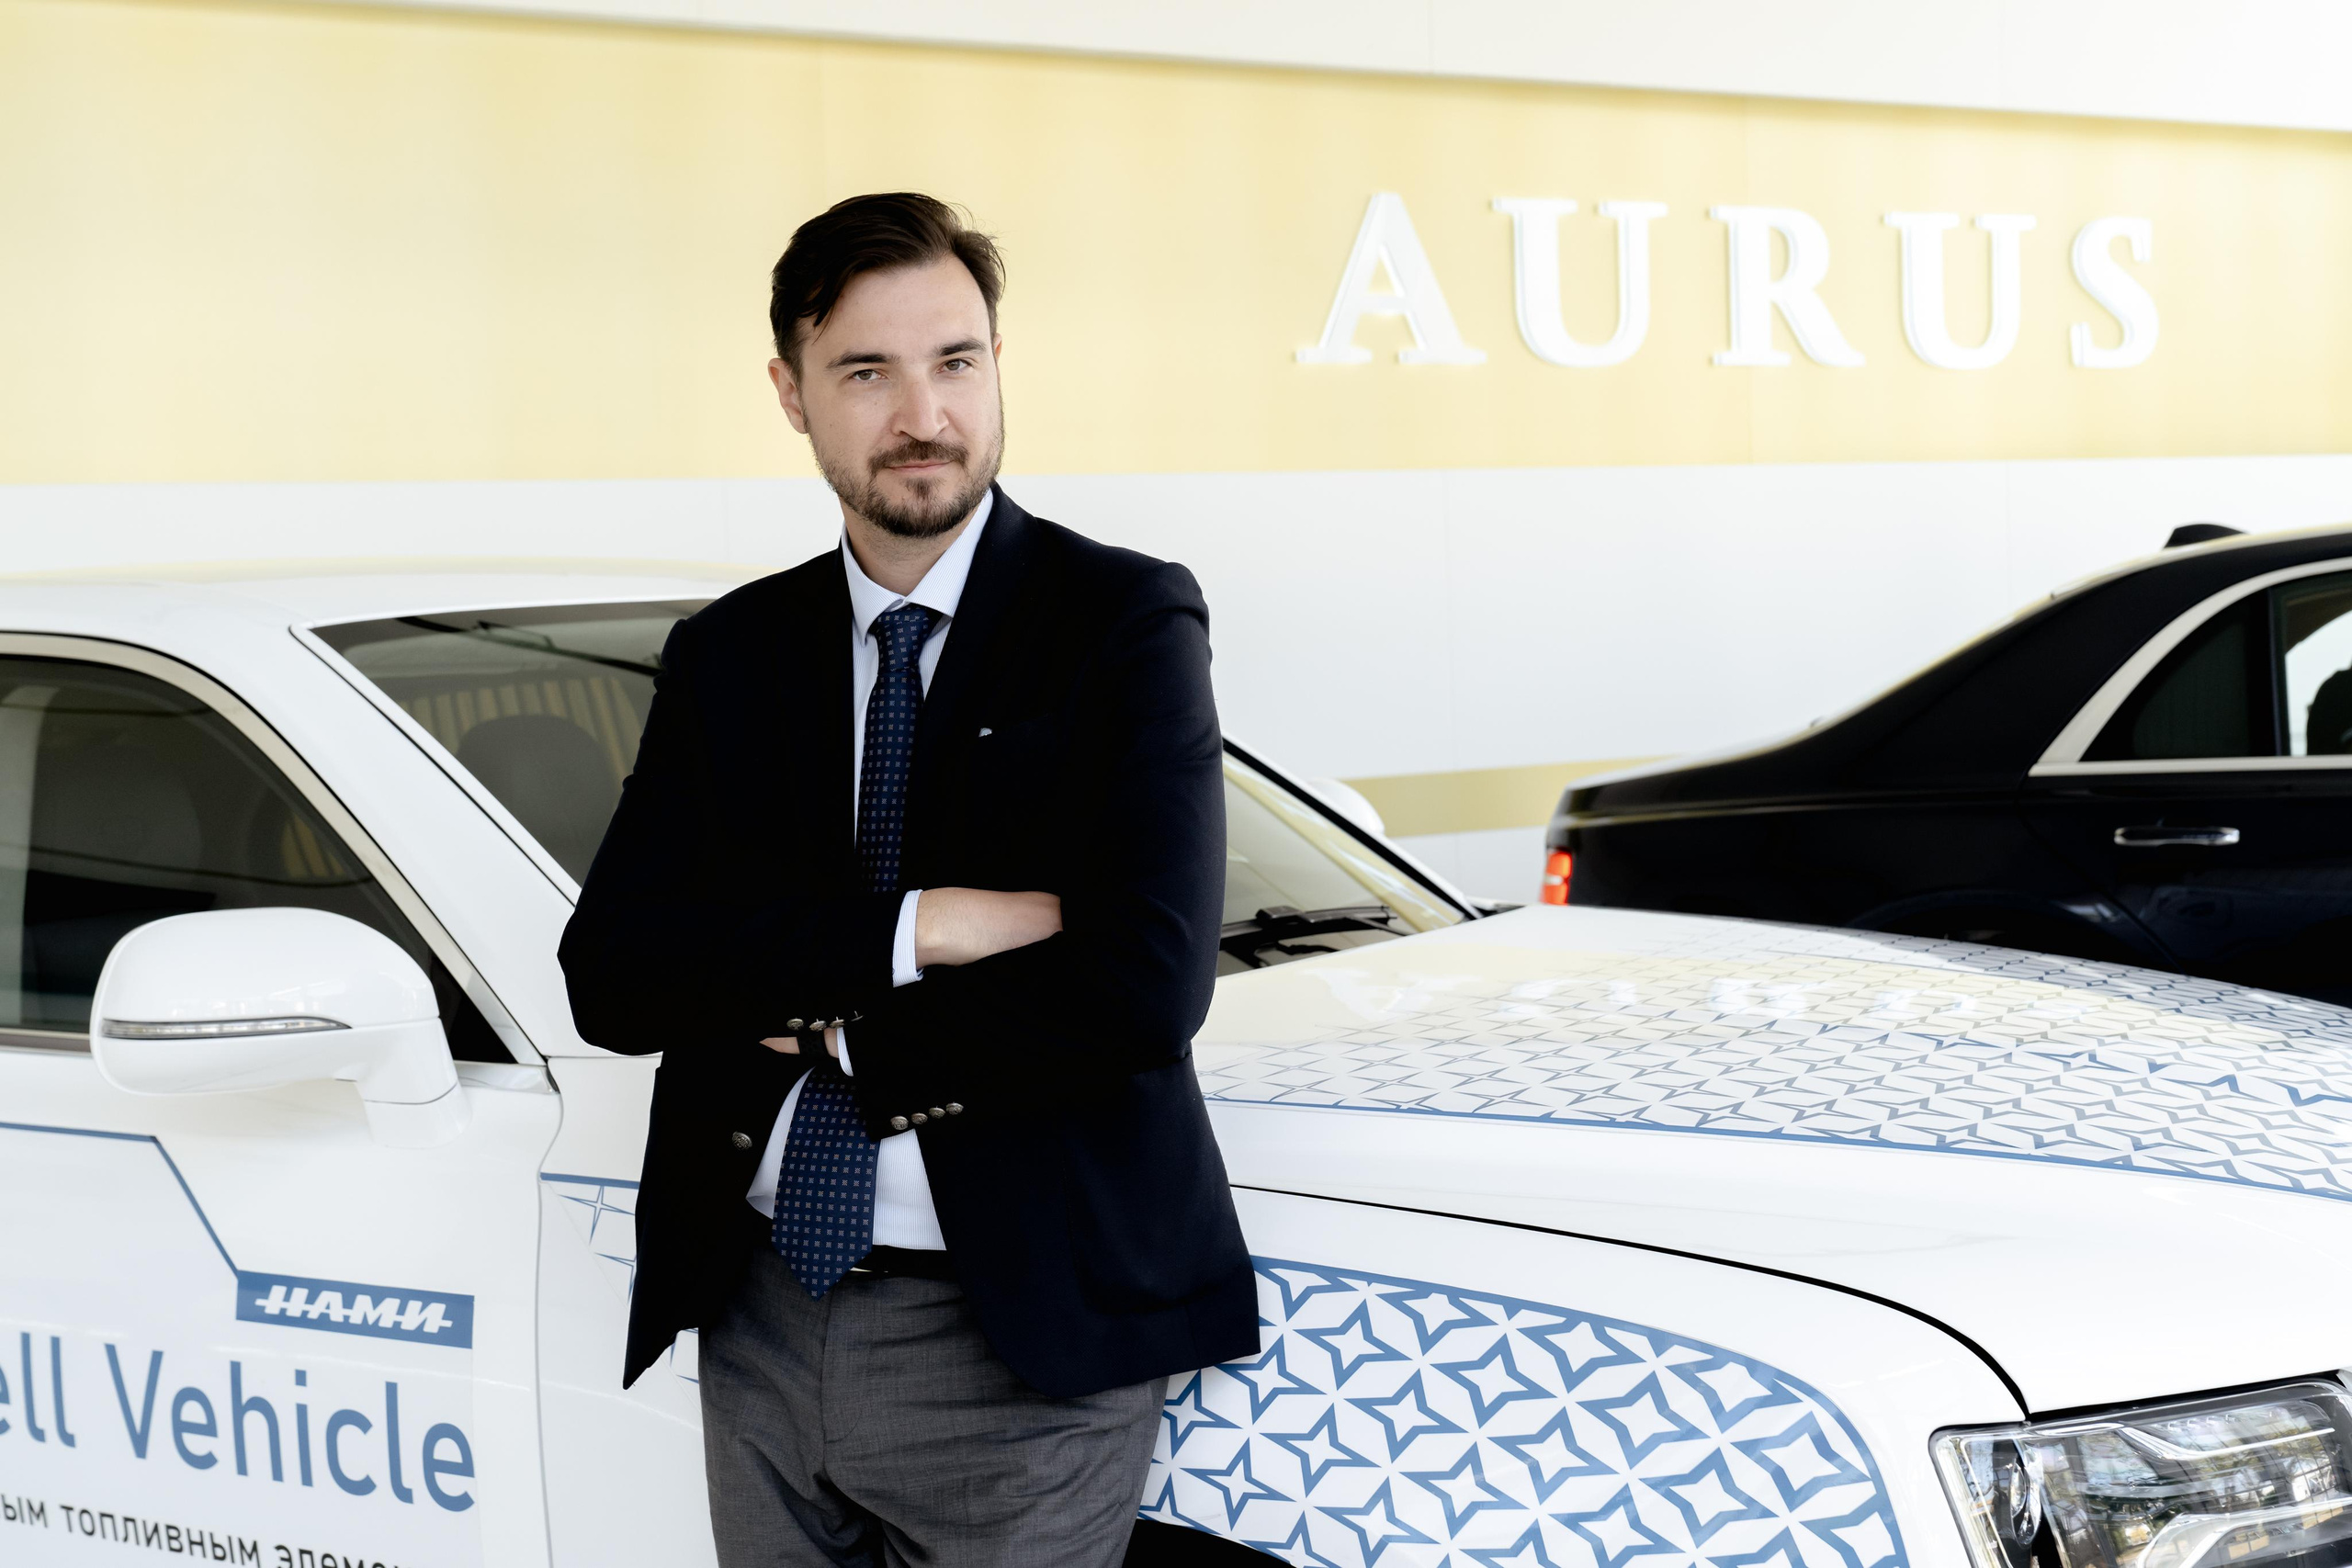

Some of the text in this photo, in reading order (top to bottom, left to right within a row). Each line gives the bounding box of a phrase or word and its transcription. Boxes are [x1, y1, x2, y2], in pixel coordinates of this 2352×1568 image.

[1294, 190, 2162, 368] AURUS
[254, 1284, 454, 1334] НАМИ
[0, 1331, 475, 1513] ll Vehicle
[59, 1504, 261, 1568] топливным
